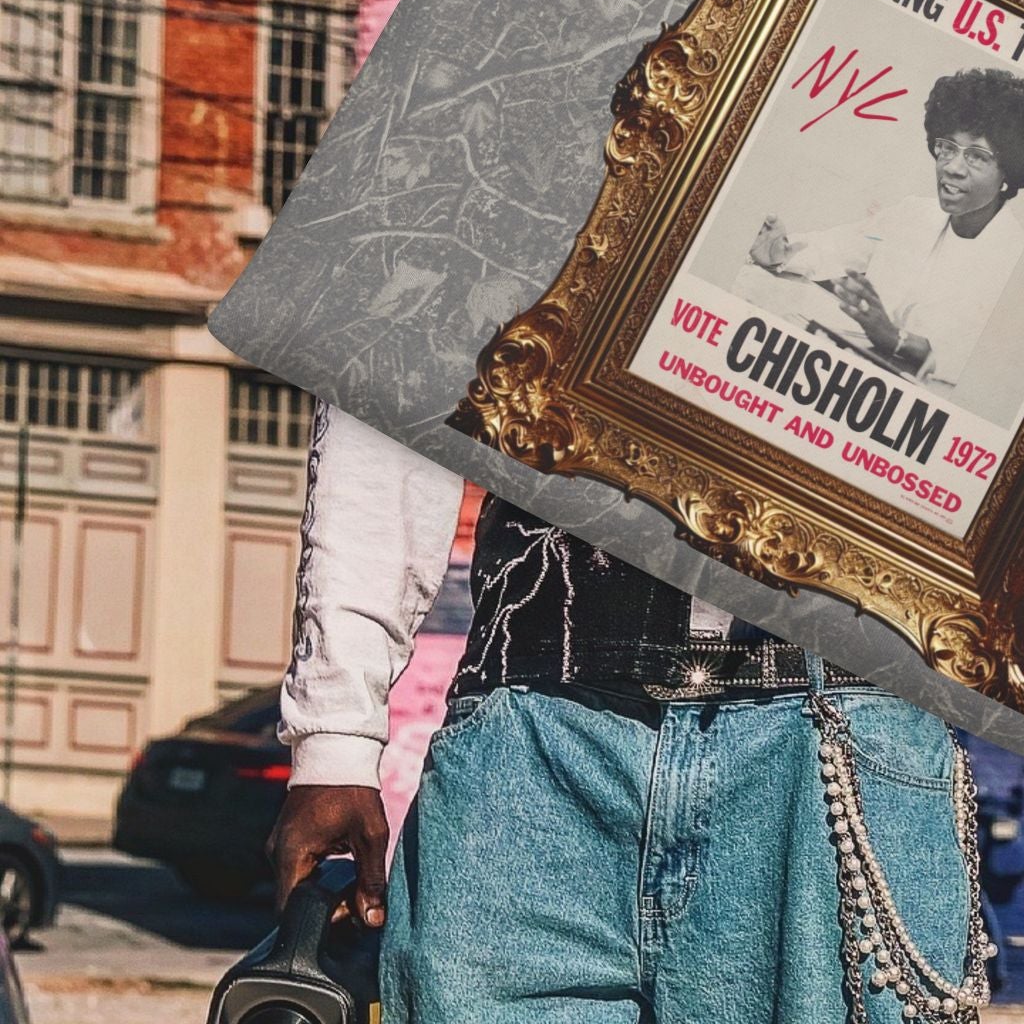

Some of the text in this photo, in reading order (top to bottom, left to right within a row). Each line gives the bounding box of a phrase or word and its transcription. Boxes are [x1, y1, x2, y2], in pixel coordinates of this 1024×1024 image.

[791, 45, 908, 132] NYC
[658, 350, 784, 423] UNBOUGHT
[783, 415, 834, 449] AND
[841, 441, 962, 513] UNBOSSED
[670, 298, 997, 480] VOTE CHISHOLM 1972
